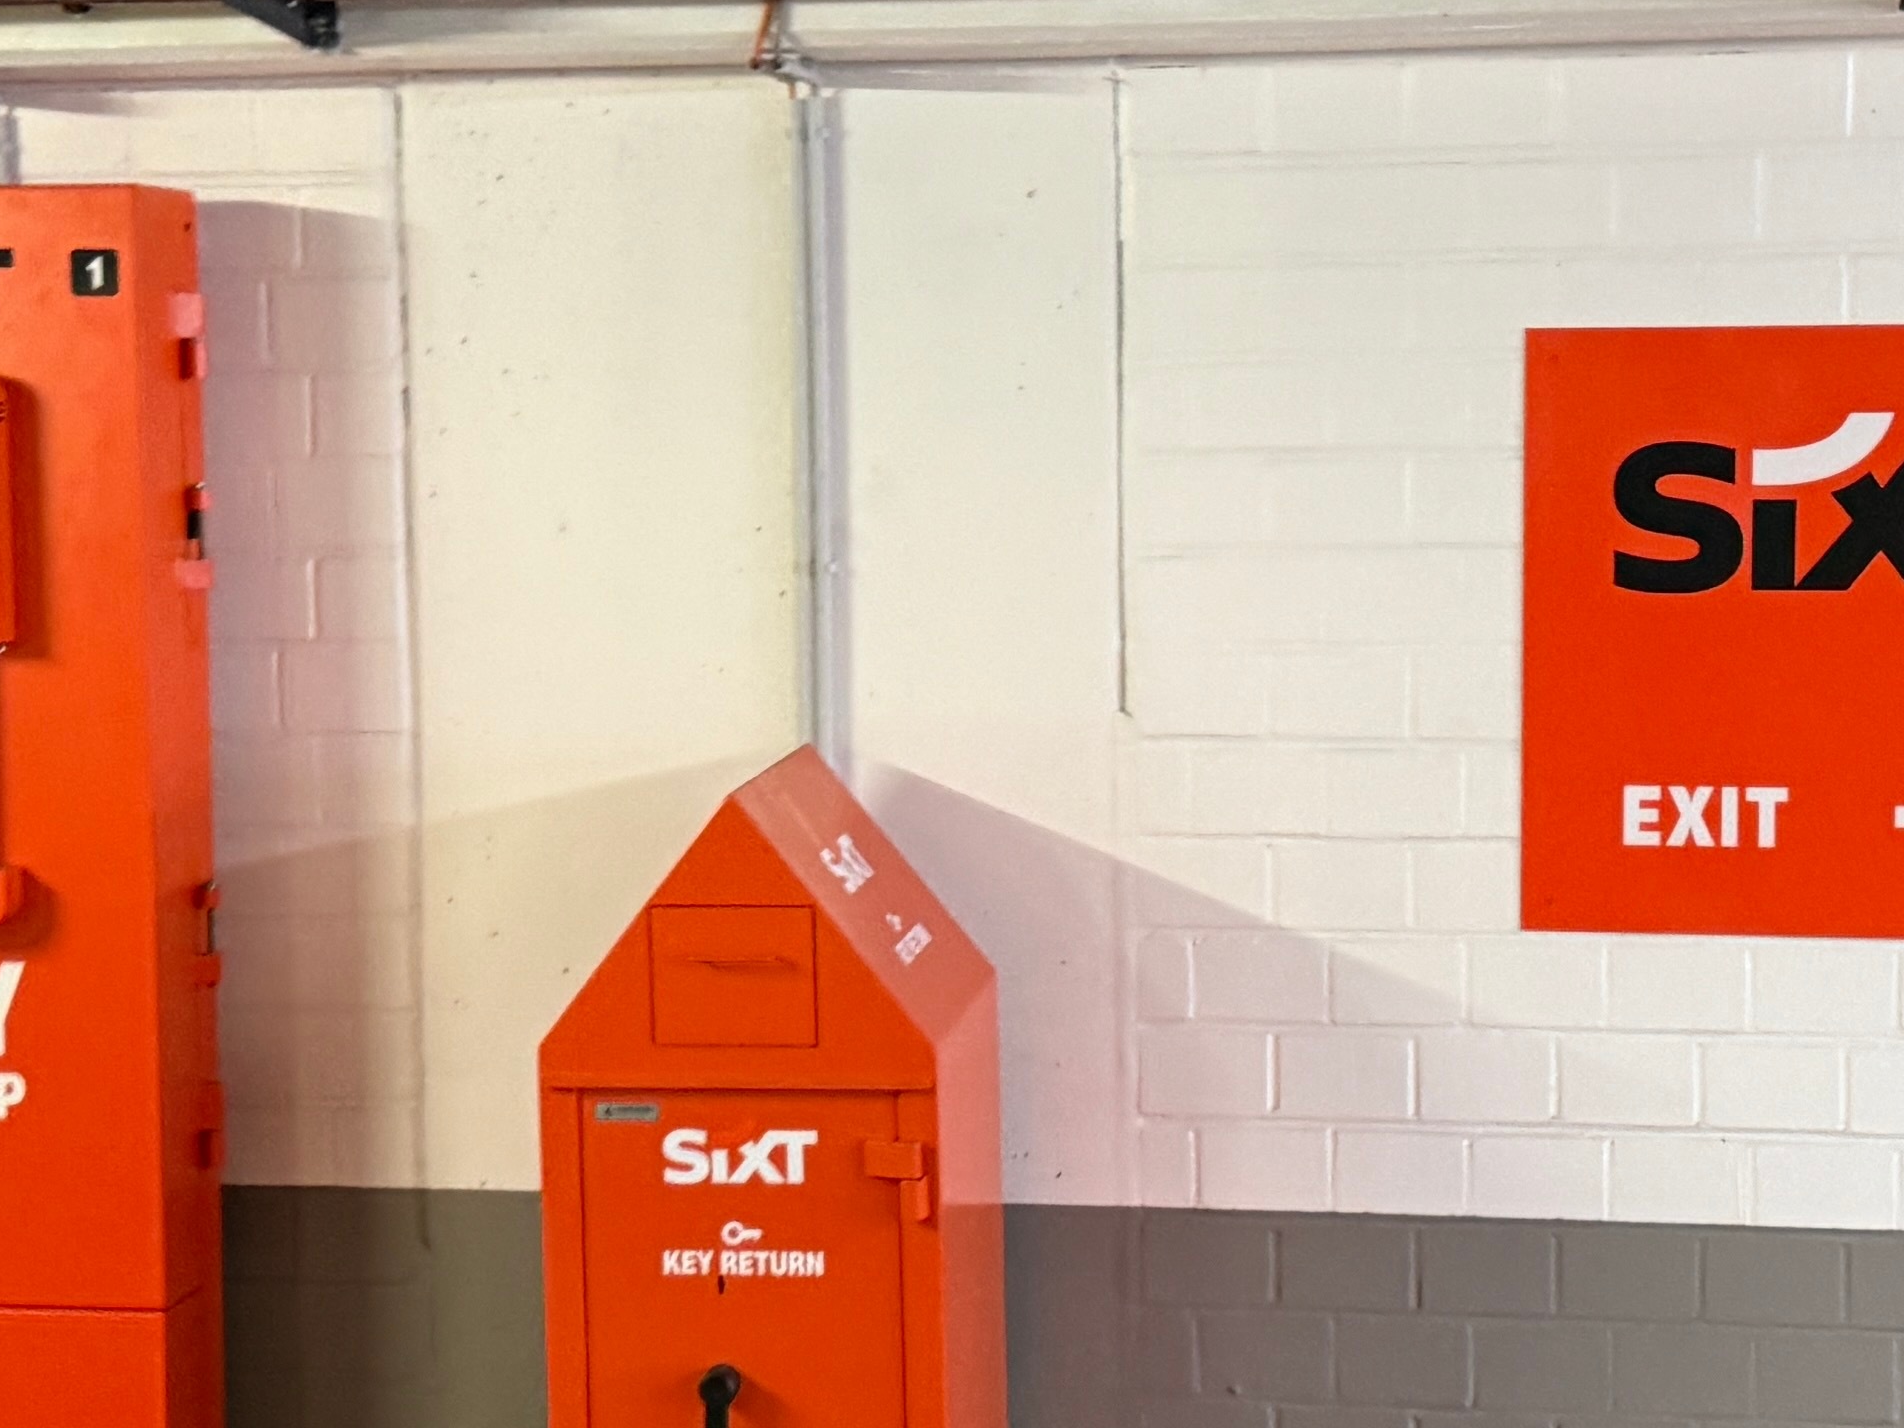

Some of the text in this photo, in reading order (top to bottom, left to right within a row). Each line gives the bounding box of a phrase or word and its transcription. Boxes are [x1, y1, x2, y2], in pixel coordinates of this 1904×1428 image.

[84, 254, 105, 291] 1
[1622, 783, 1790, 848] EXIT
[662, 1249, 826, 1278] KEY RETURN
